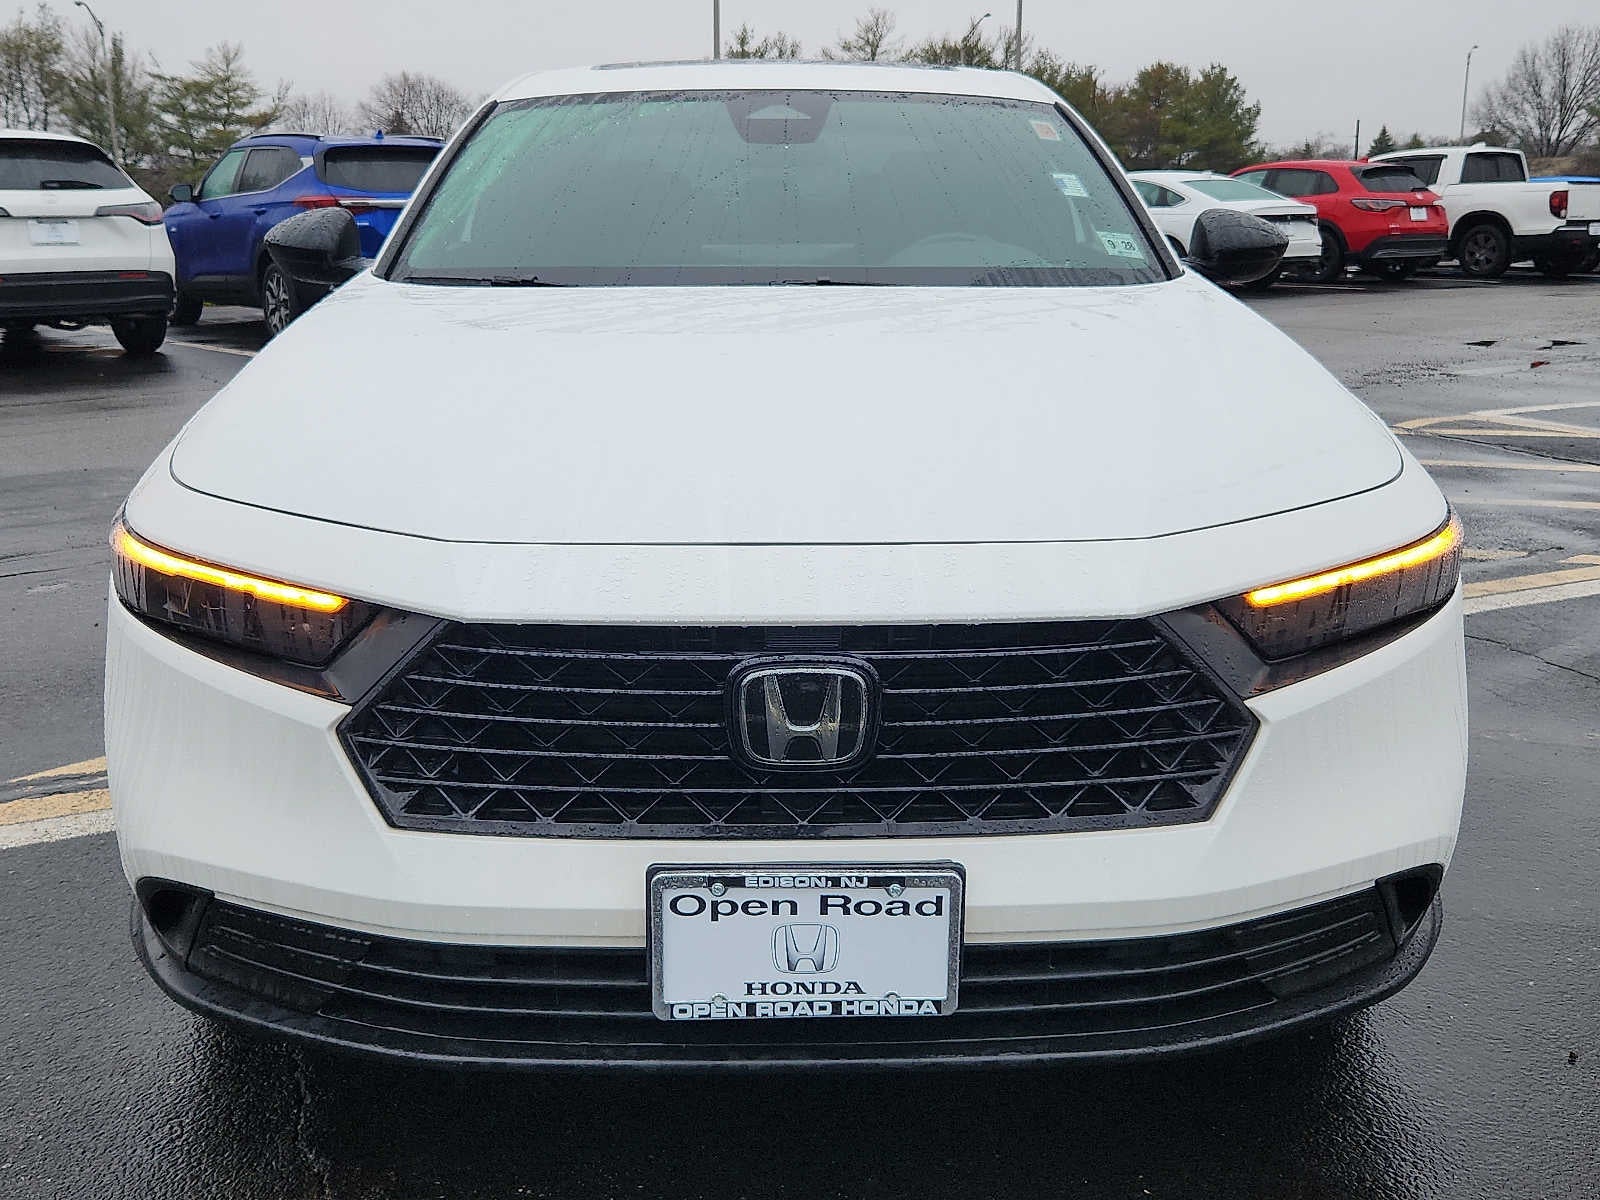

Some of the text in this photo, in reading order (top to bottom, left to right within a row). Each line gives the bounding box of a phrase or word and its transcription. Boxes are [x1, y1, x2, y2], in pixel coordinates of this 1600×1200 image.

[745, 875, 869, 888] EDISON, NJ
[669, 894, 944, 922] Open Road
[744, 981, 867, 996] HONDA
[672, 999, 938, 1019] OPEN ROAD HONDA
